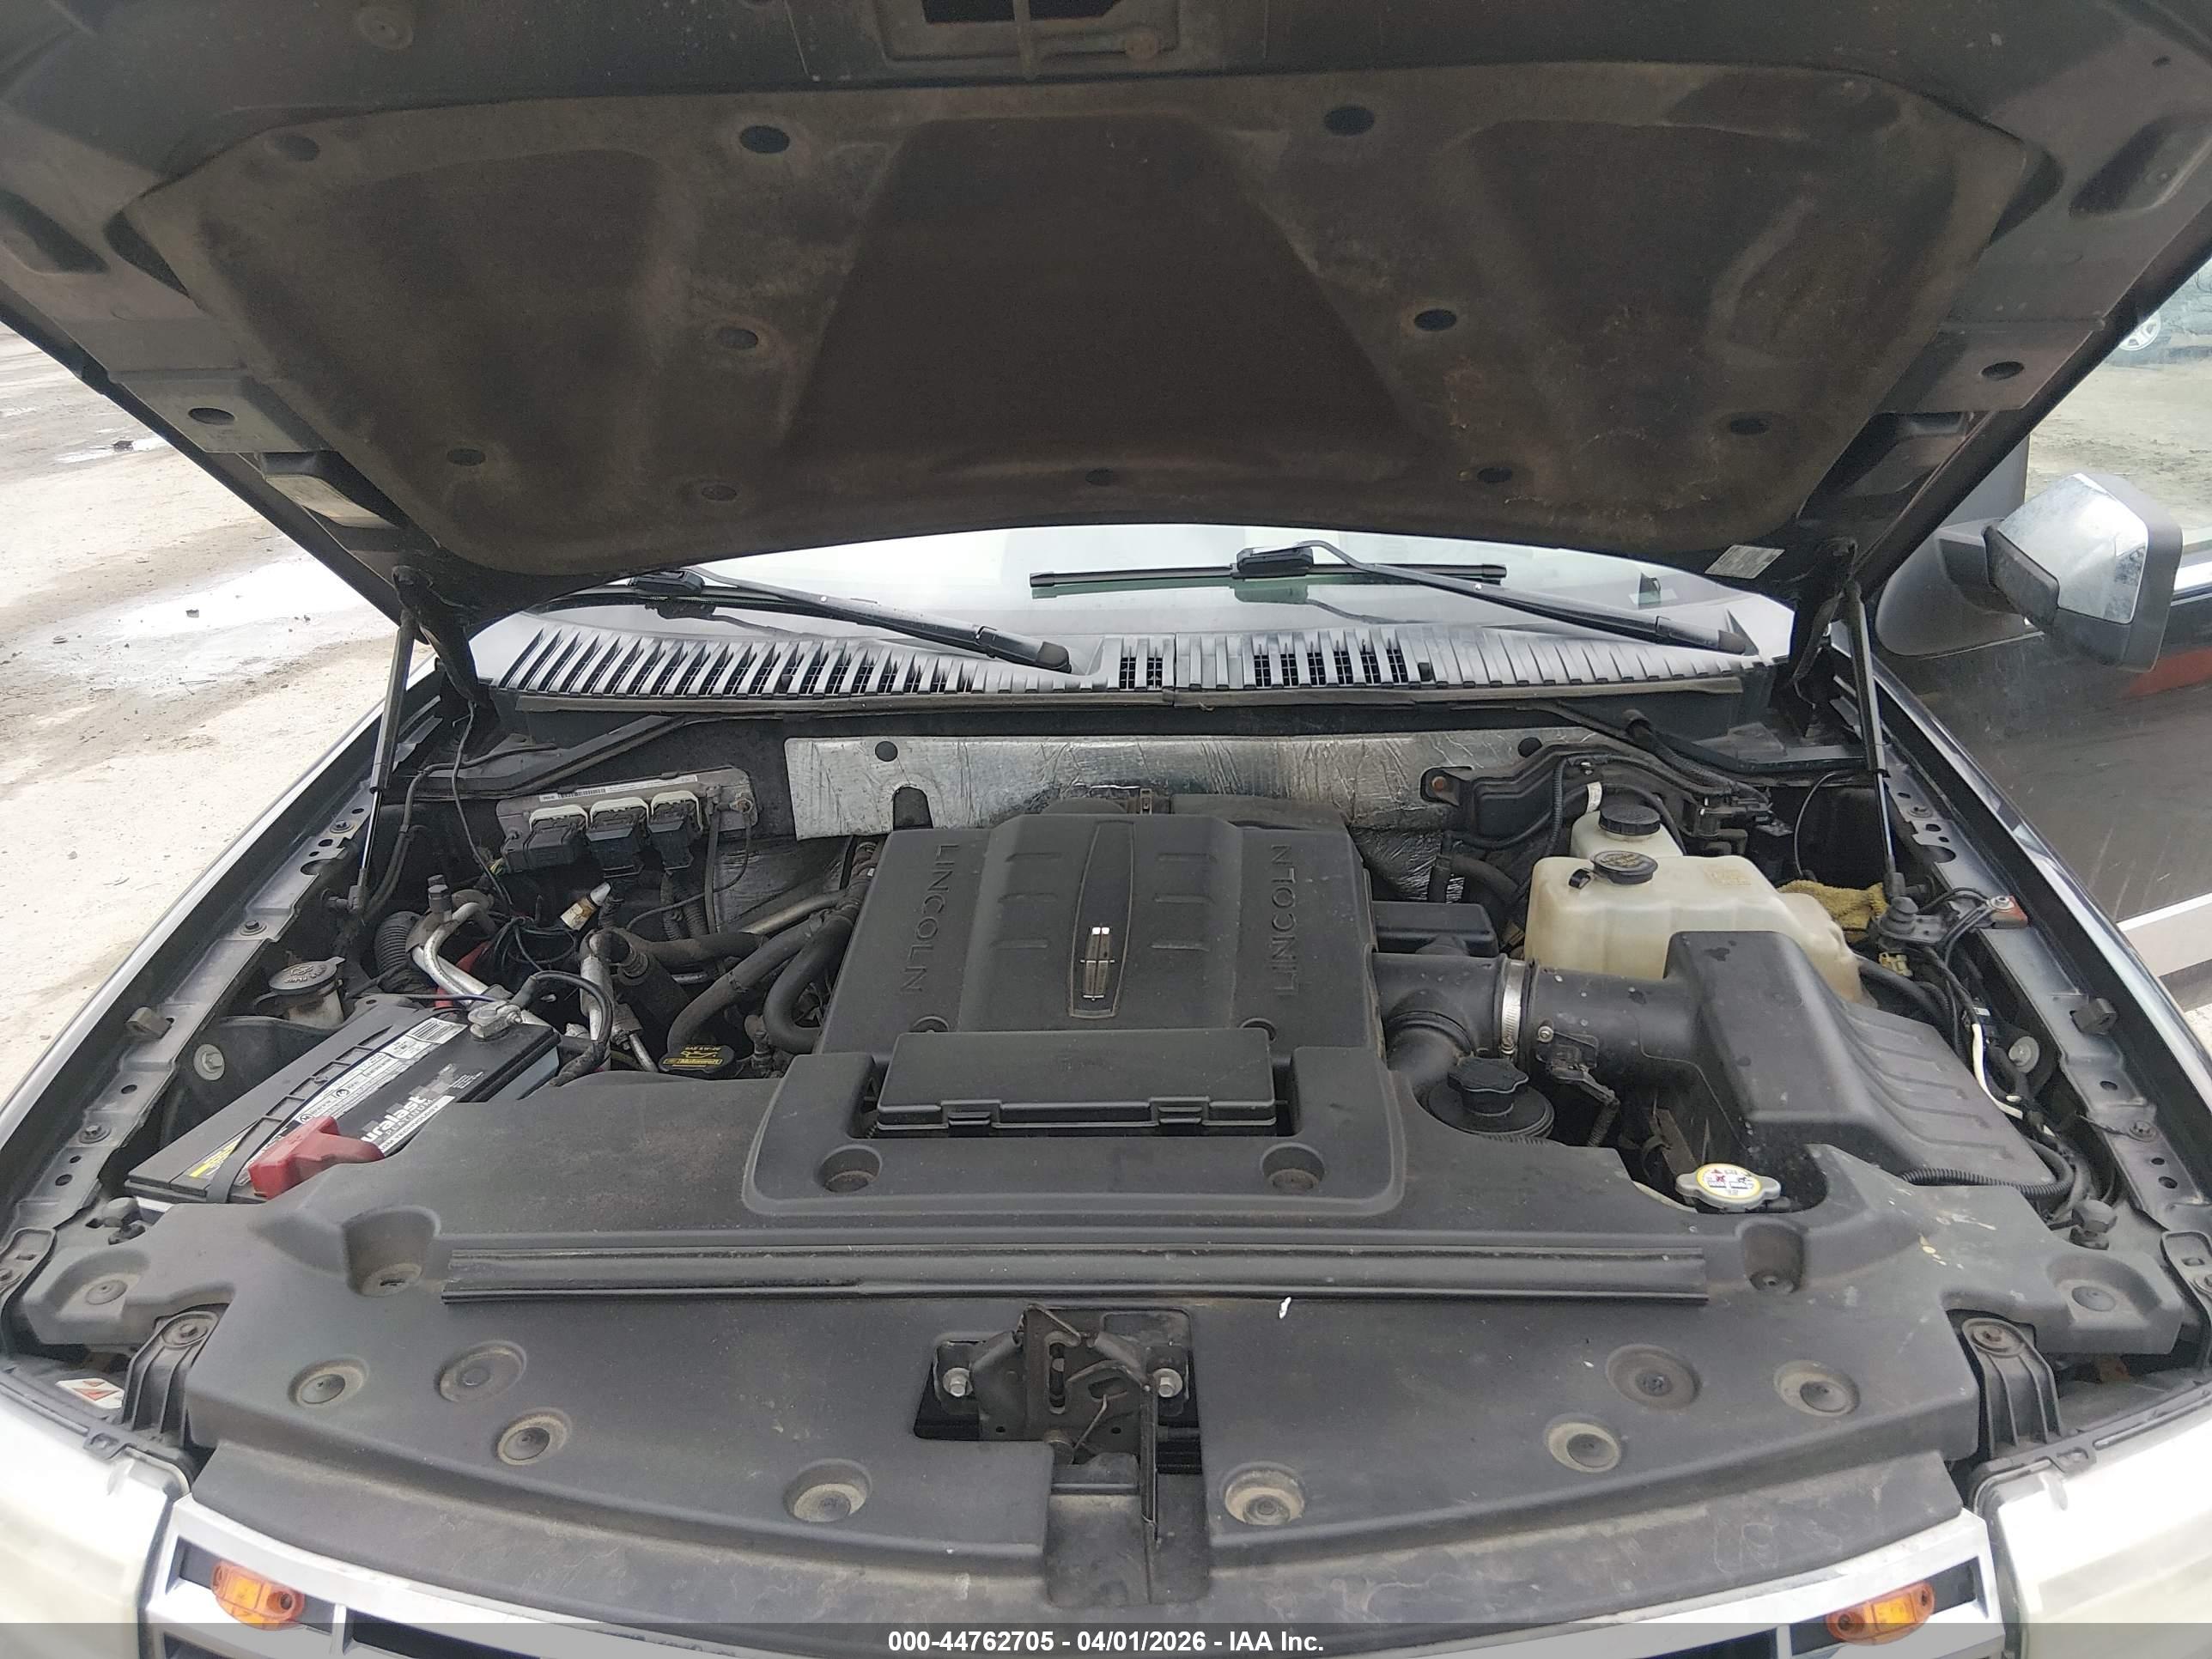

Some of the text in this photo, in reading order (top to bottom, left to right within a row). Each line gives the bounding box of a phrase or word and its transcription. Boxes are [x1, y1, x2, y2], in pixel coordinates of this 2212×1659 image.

[901, 843, 959, 994] LINCOLN
[1270, 844, 1298, 996] LINCOLN
[361, 1095, 428, 1143] uralast
[386, 1097, 434, 1135] PLATINUM
[396, 1104, 440, 1139] TECHNOLOGY
